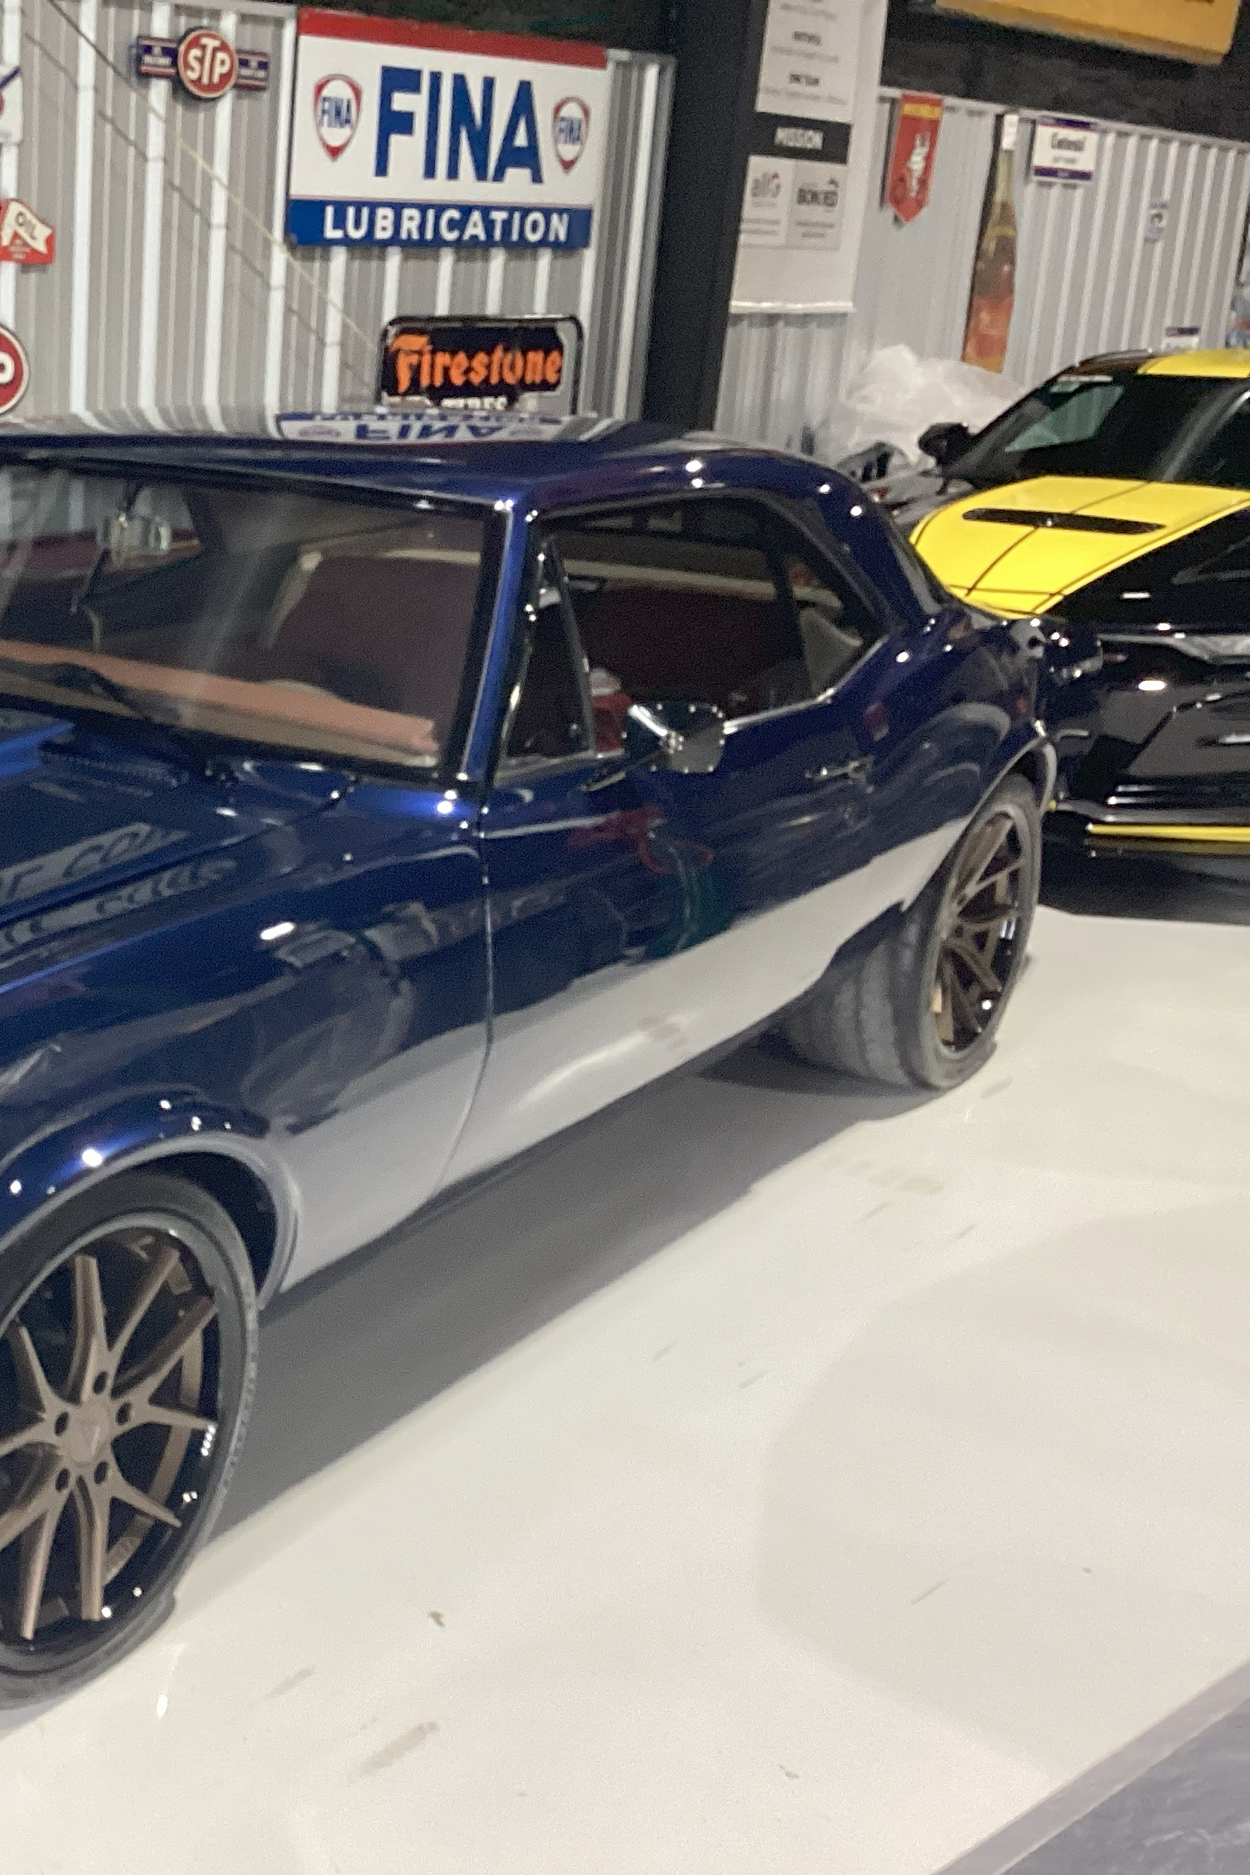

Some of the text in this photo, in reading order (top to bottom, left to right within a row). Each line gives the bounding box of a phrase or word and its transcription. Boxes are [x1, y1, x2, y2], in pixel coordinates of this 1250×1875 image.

[186, 37, 231, 84] STP
[319, 97, 353, 129] FINA
[374, 65, 544, 184] FINA
[555, 116, 583, 145] FINA
[14, 210, 38, 240] OIL
[323, 204, 570, 243] LUBRICATION
[390, 334, 564, 393] Firestone
